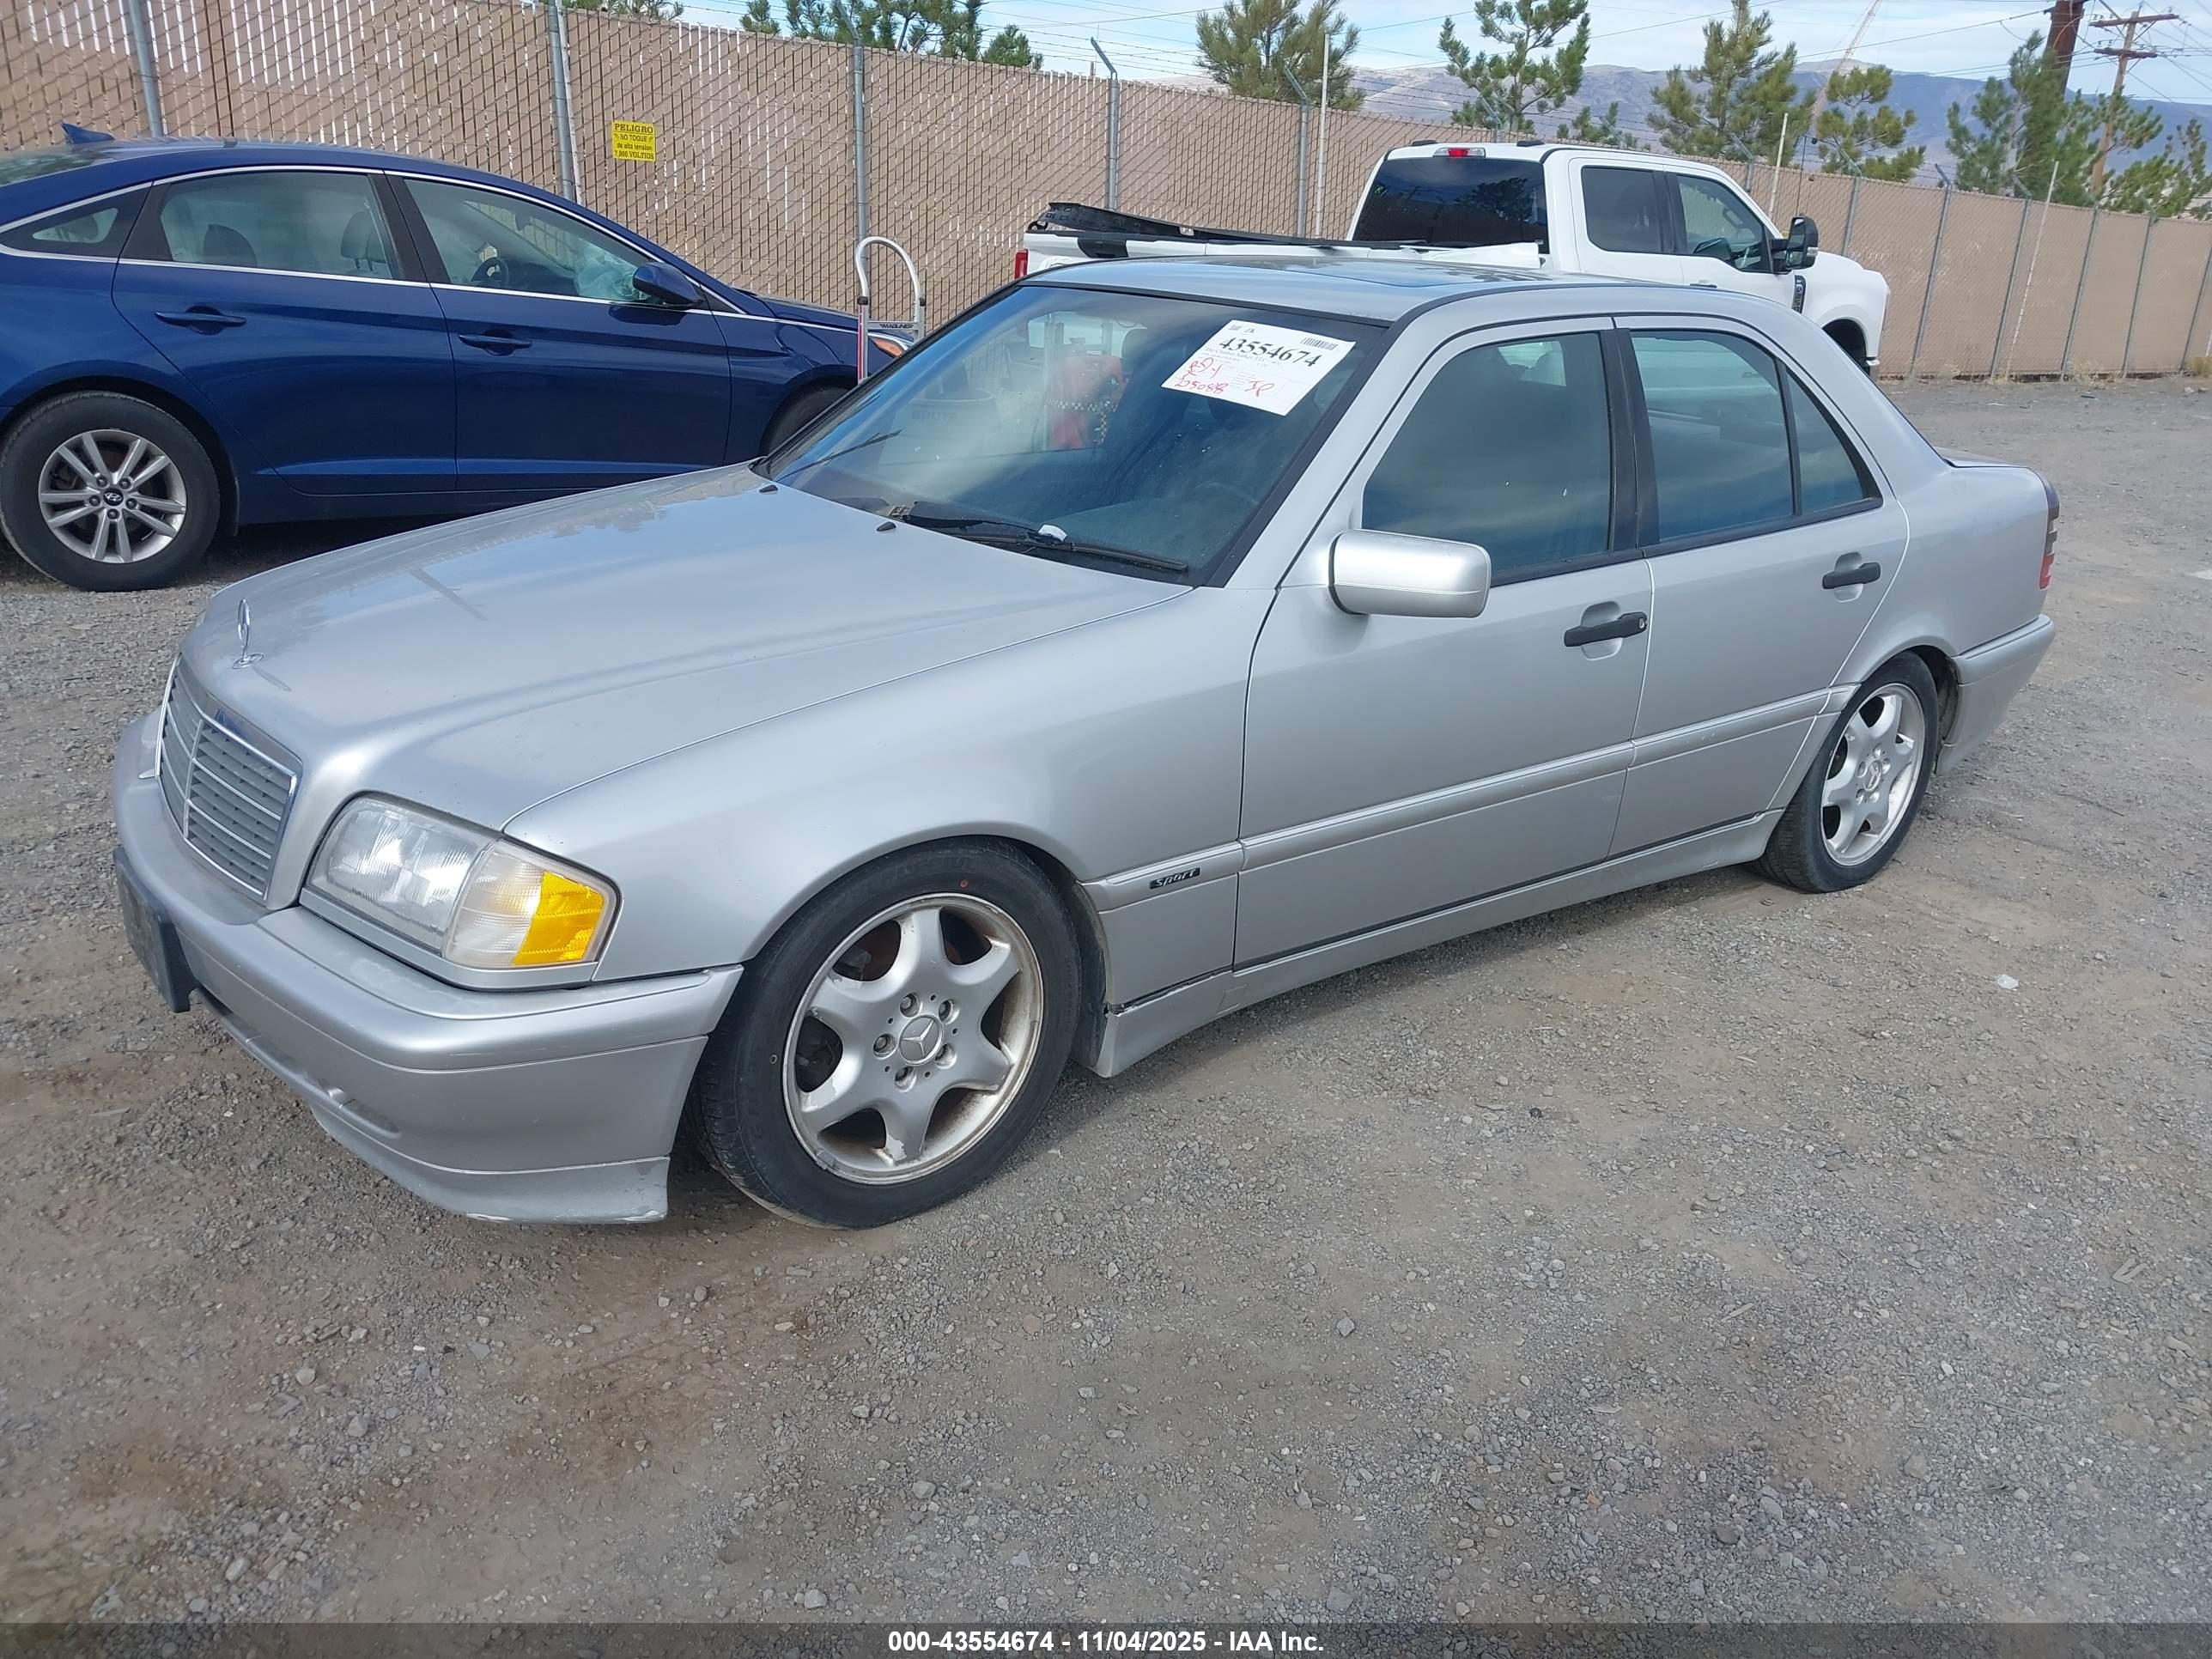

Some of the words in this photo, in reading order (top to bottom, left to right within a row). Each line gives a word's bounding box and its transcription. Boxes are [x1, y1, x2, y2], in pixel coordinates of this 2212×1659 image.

[614, 123, 653, 133] PELIGRO
[629, 151, 654, 160] VOLTIOS
[1219, 337, 1322, 368] 43554674
